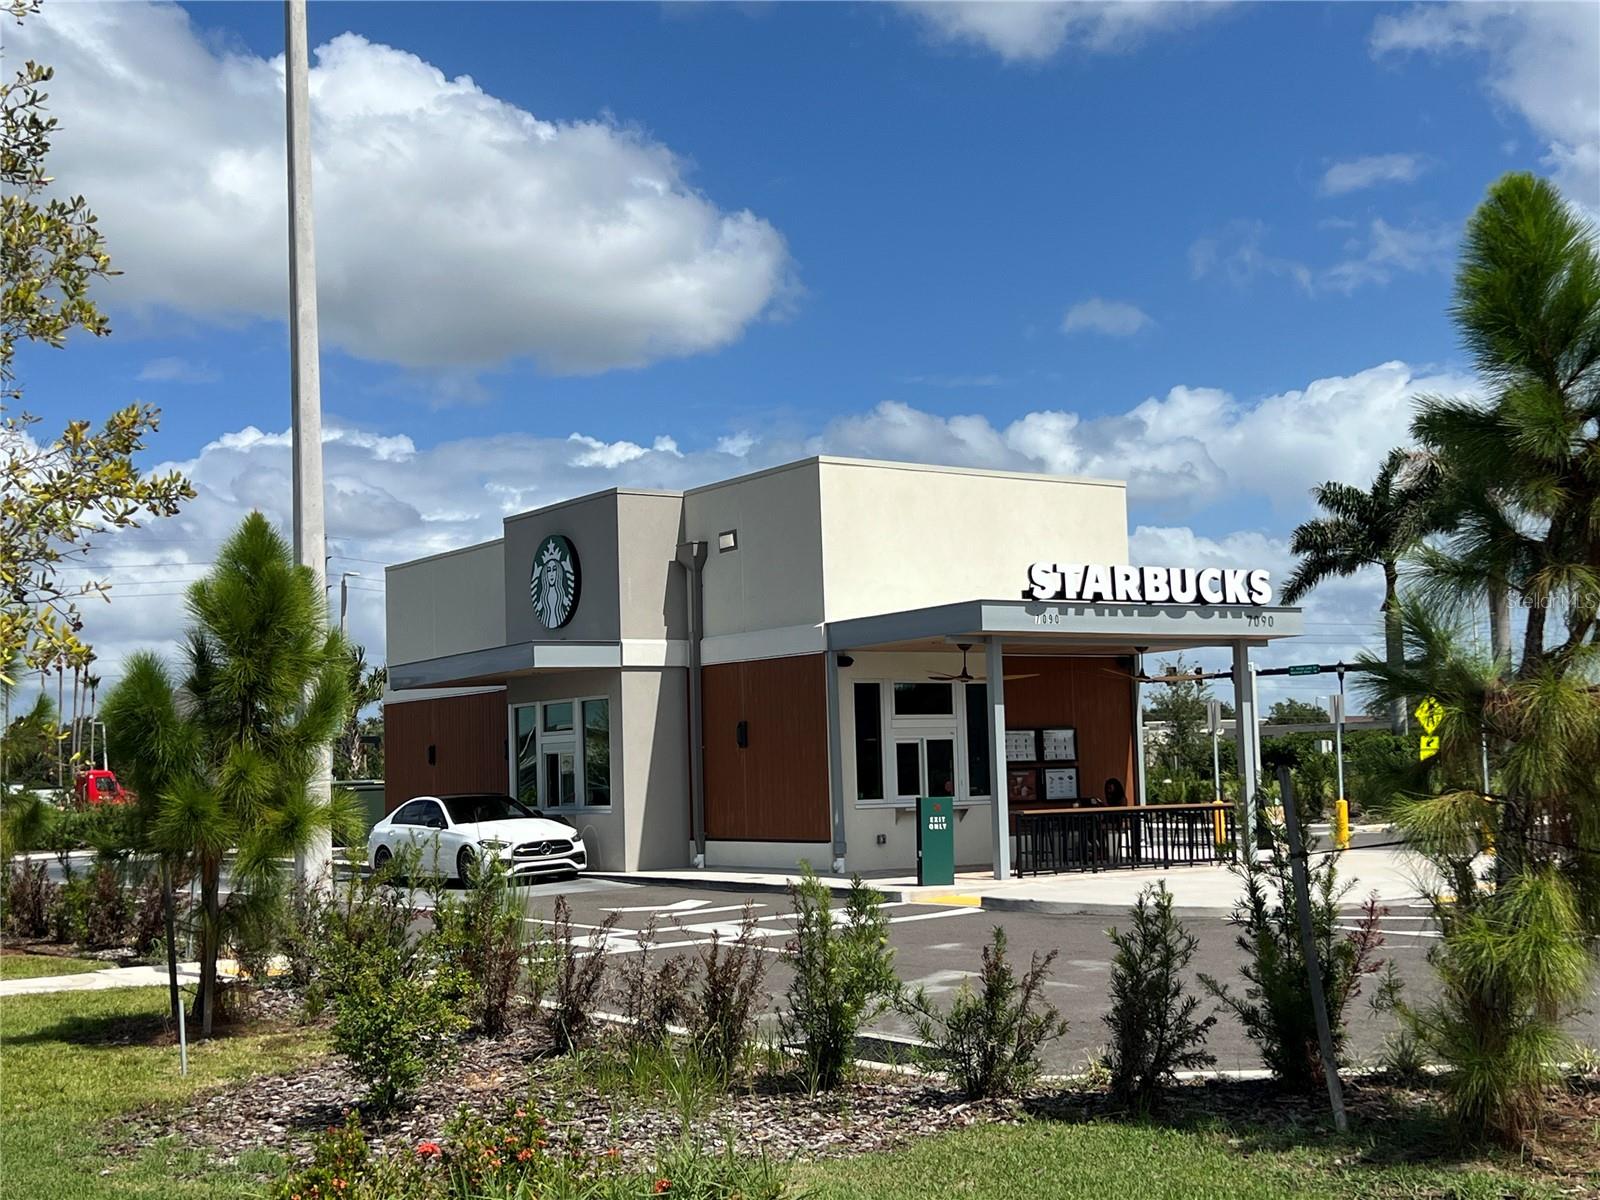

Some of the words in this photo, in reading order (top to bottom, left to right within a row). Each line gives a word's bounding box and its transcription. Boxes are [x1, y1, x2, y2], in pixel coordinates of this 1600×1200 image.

[1029, 562, 1273, 604] STARBUCKS
[1034, 614, 1060, 624] 7090
[1246, 615, 1274, 627] 7090
